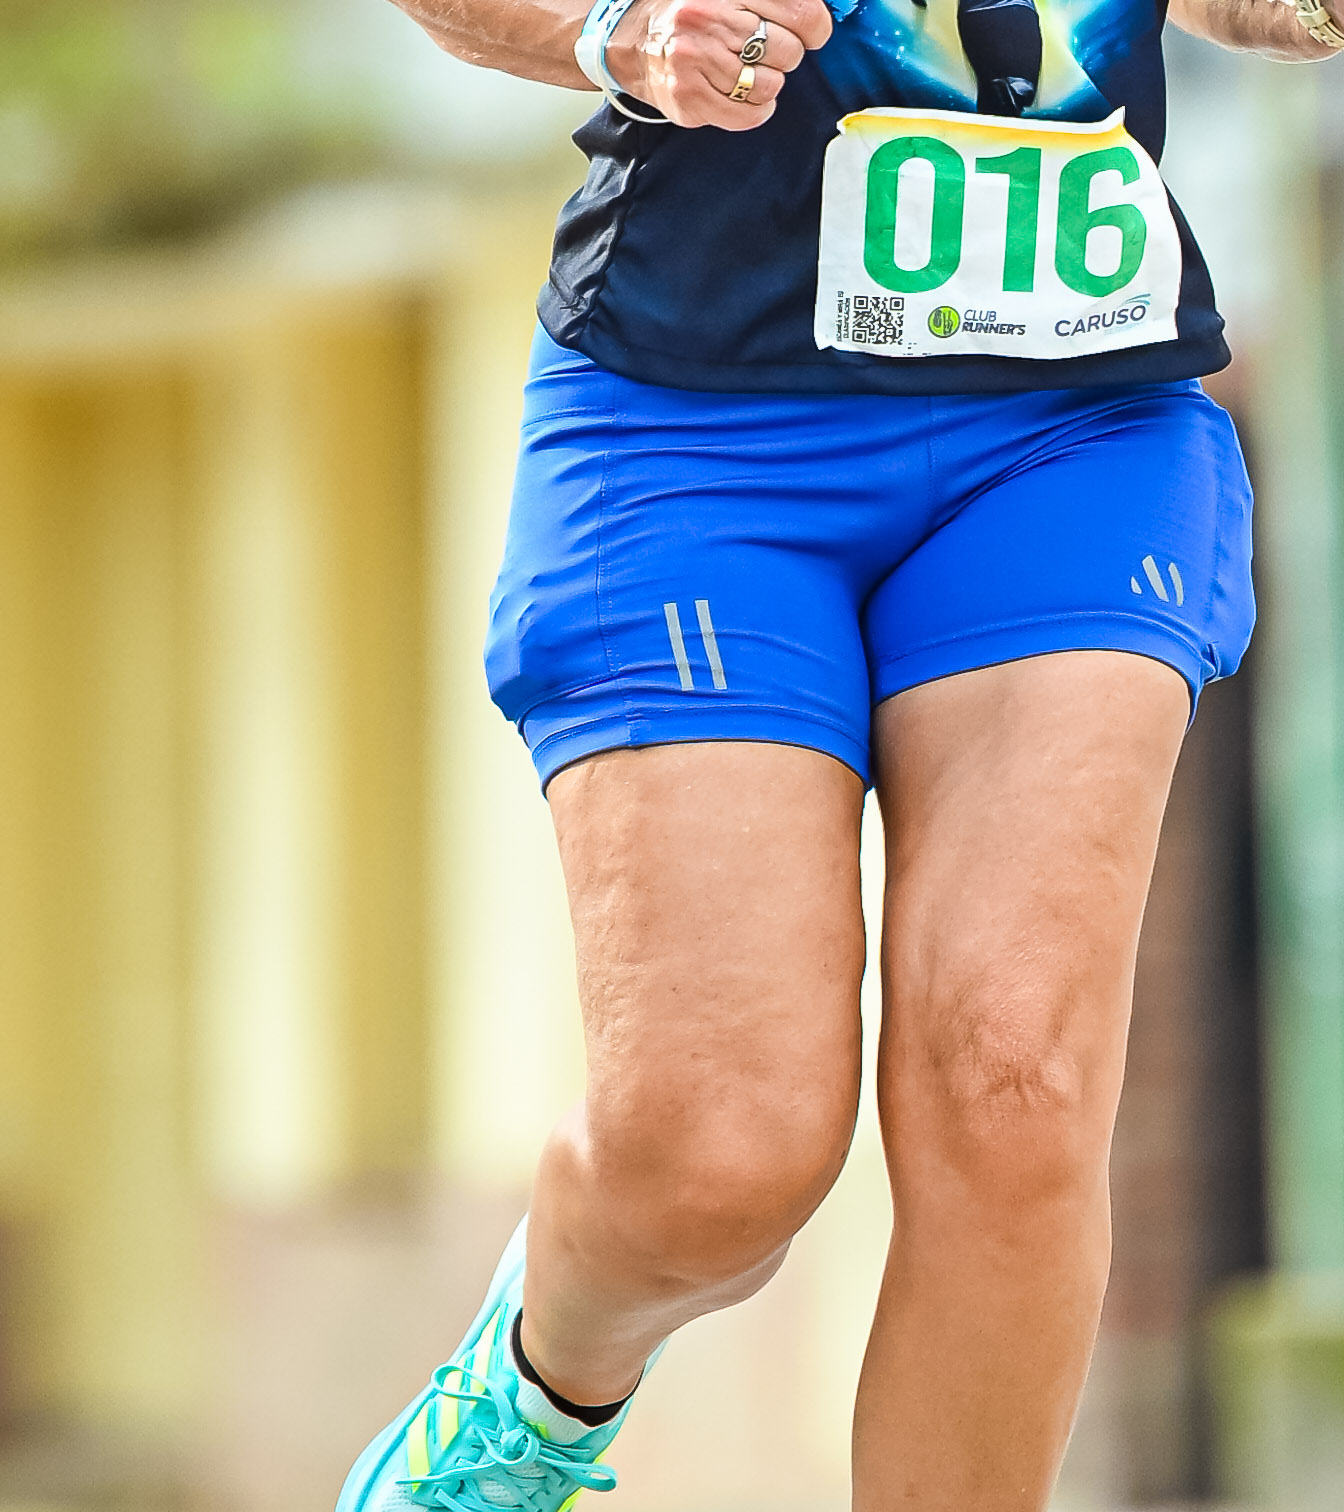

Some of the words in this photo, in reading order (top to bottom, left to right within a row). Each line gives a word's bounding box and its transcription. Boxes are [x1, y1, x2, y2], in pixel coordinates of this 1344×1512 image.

[863, 136, 1147, 297] 016
[963, 309, 997, 322] CLUB
[1054, 304, 1146, 337] CARUSO
[961, 321, 1026, 335] RUNNER'S
